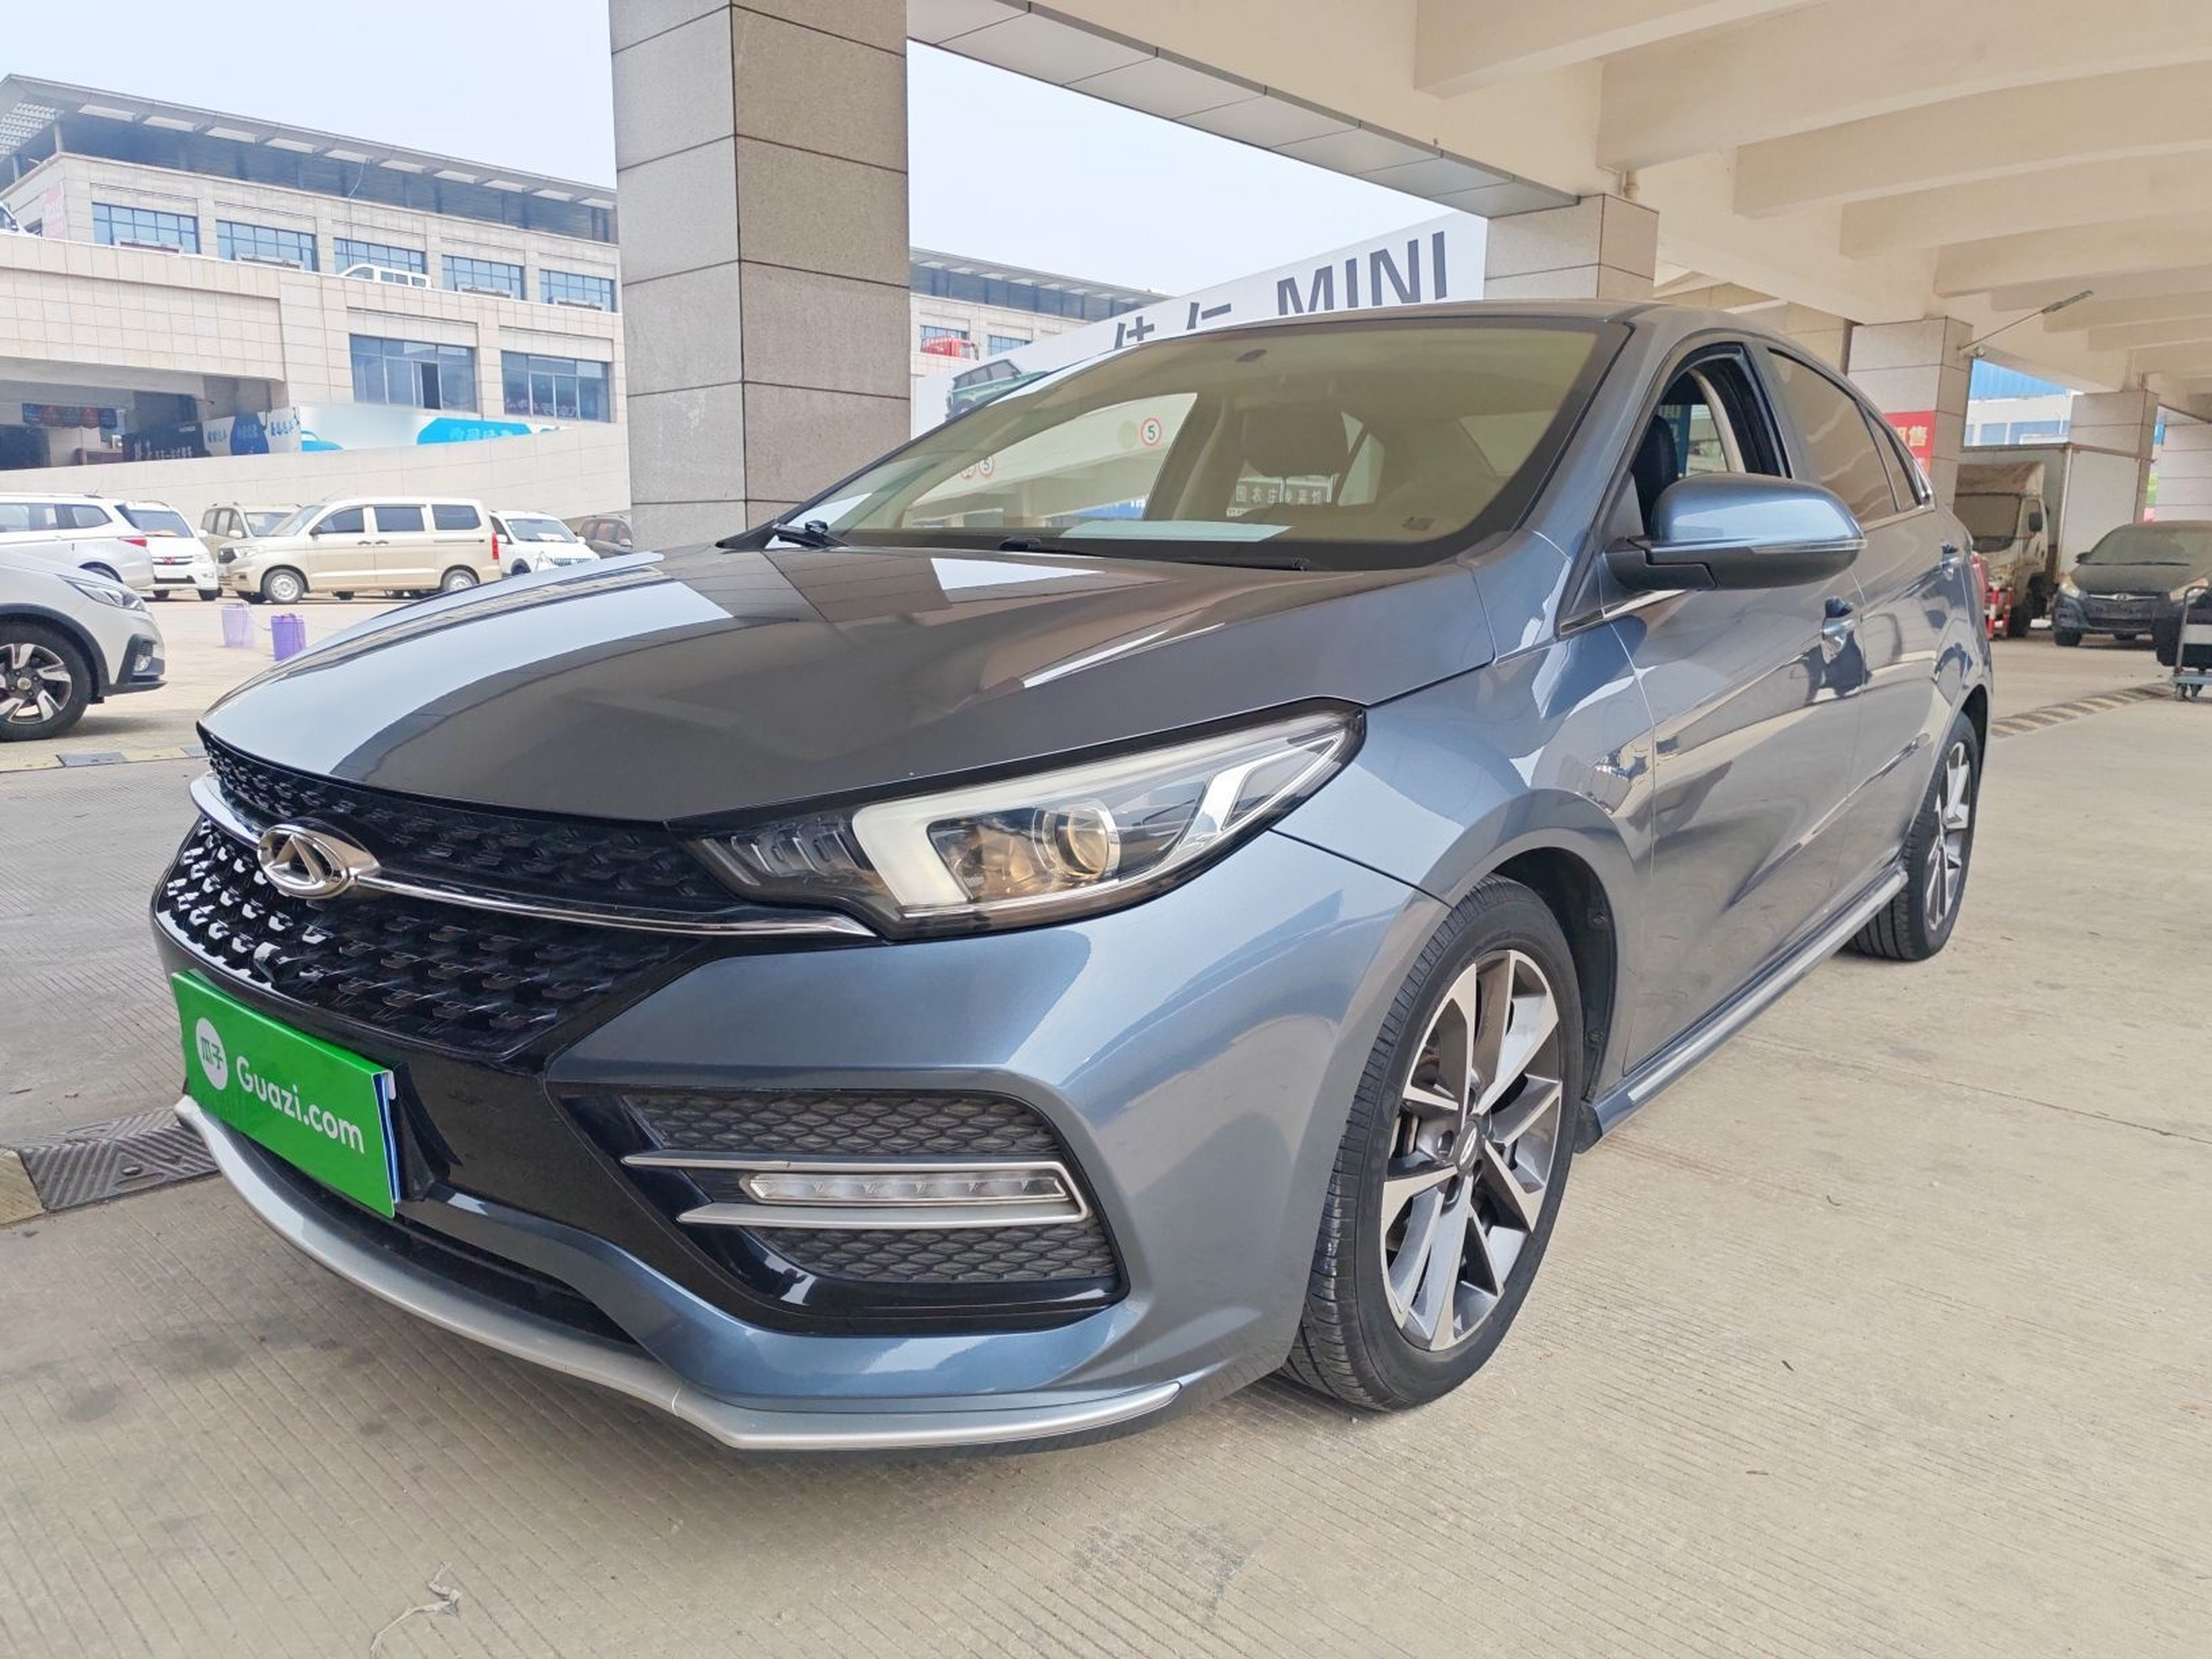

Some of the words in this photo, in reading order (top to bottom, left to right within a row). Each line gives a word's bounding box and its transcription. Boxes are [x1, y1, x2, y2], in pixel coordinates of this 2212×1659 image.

[1277, 230, 1448, 316] MINI
[1147, 425, 1156, 441] 5
[200, 1036, 223, 1070] 瓜子
[236, 1056, 365, 1154] Guazi.com
